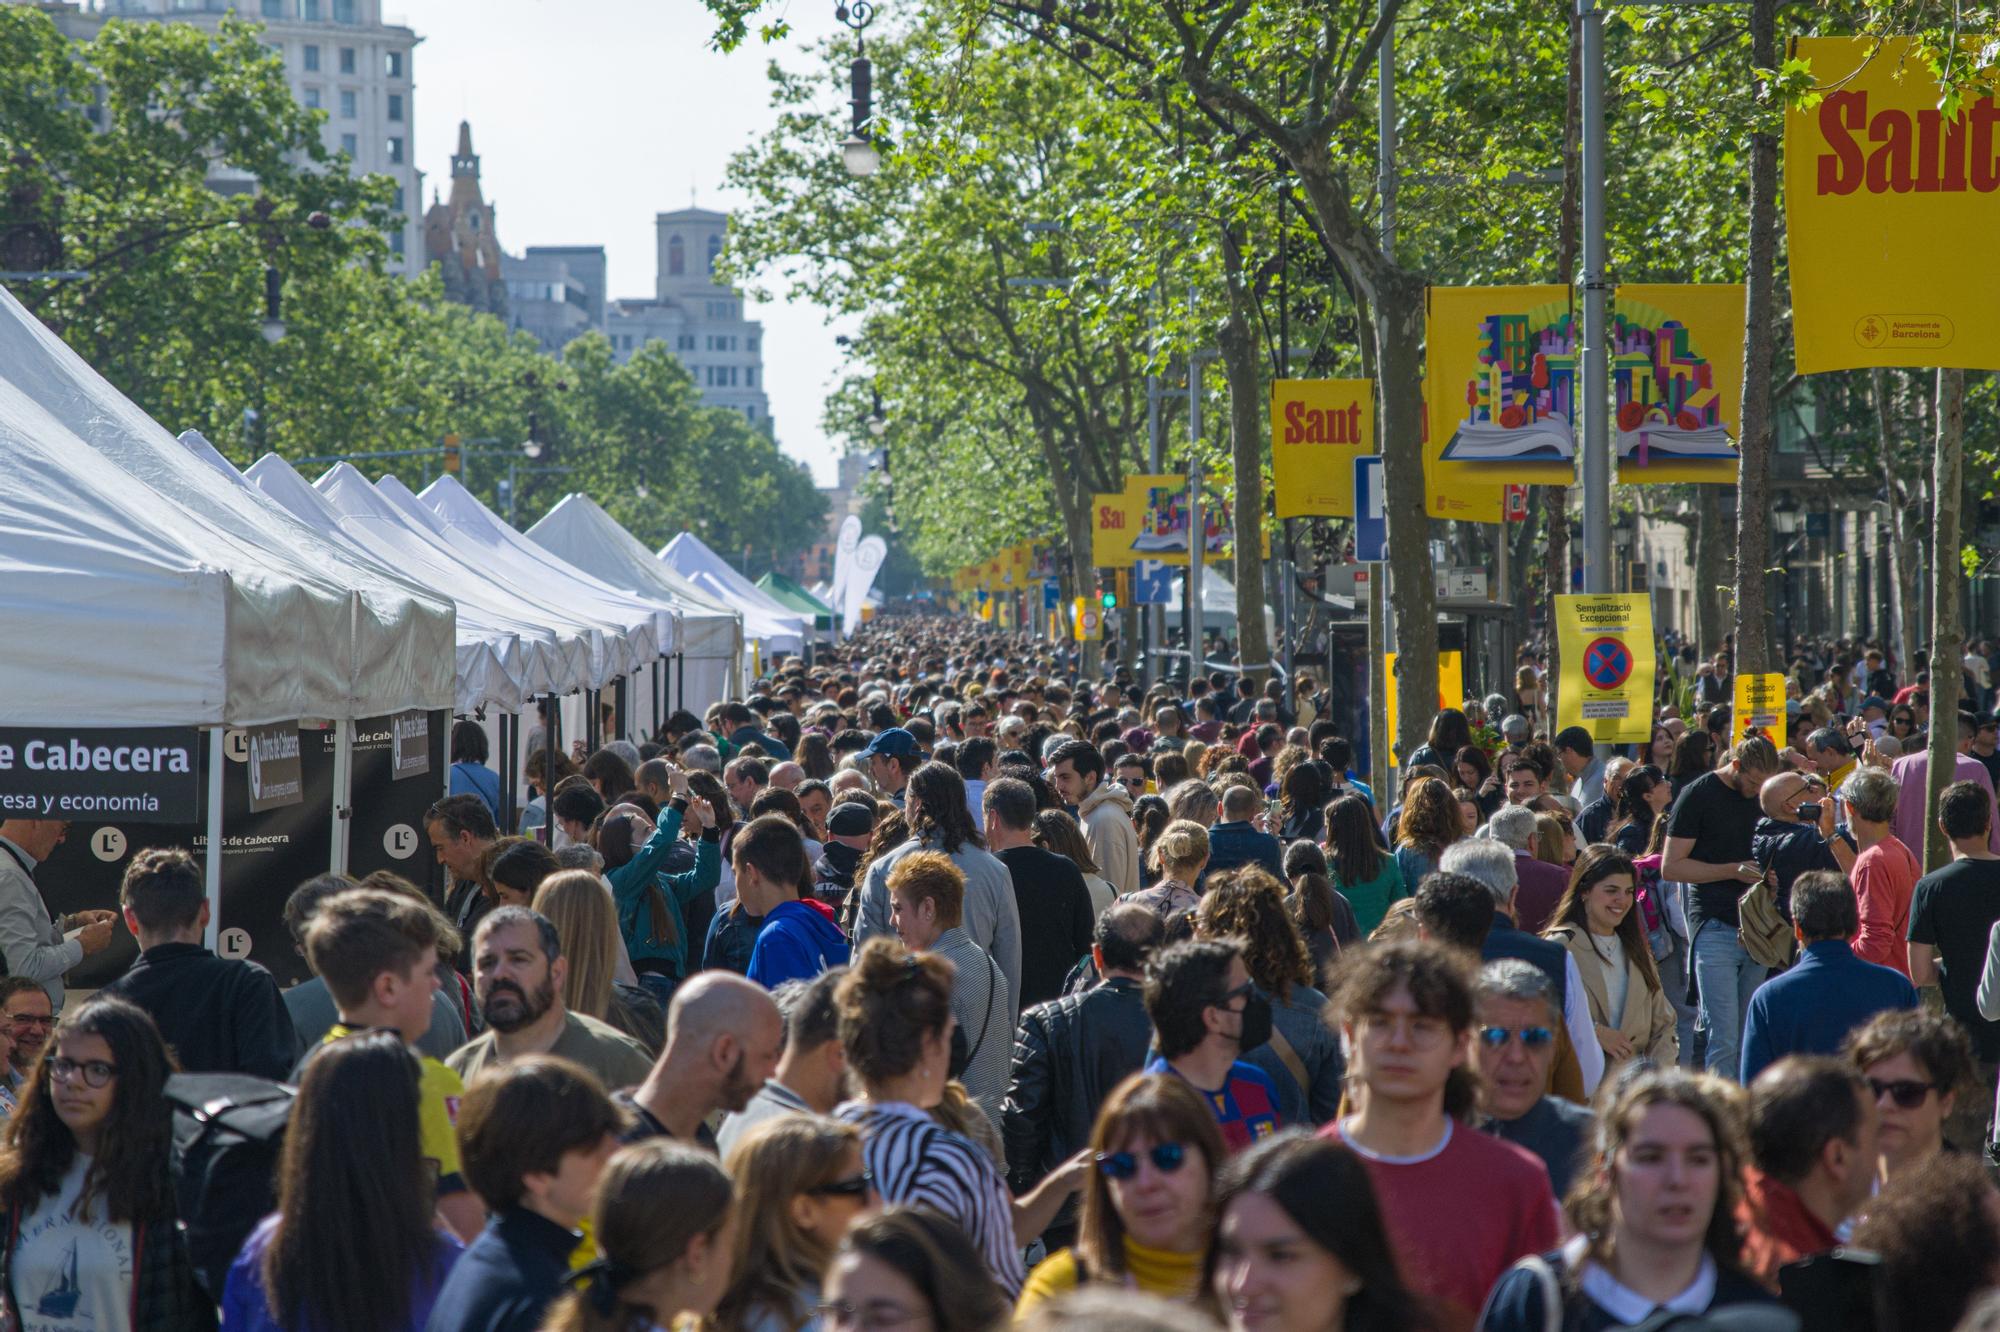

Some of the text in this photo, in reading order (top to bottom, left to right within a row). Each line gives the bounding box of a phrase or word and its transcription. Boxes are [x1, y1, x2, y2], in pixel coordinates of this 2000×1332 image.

[1892, 330, 1941, 339] Barcelona
[1284, 400, 1362, 444] Sant
[1575, 603, 1631, 614] Senyalització
[1580, 613, 1630, 623] Excepcional
[359, 732, 371, 743] de
[24, 738, 190, 773] Cabecera
[42, 796, 54, 815] y
[60, 792, 159, 812] economía
[228, 836, 242, 846] de
[243, 834, 289, 846] Cabecera
